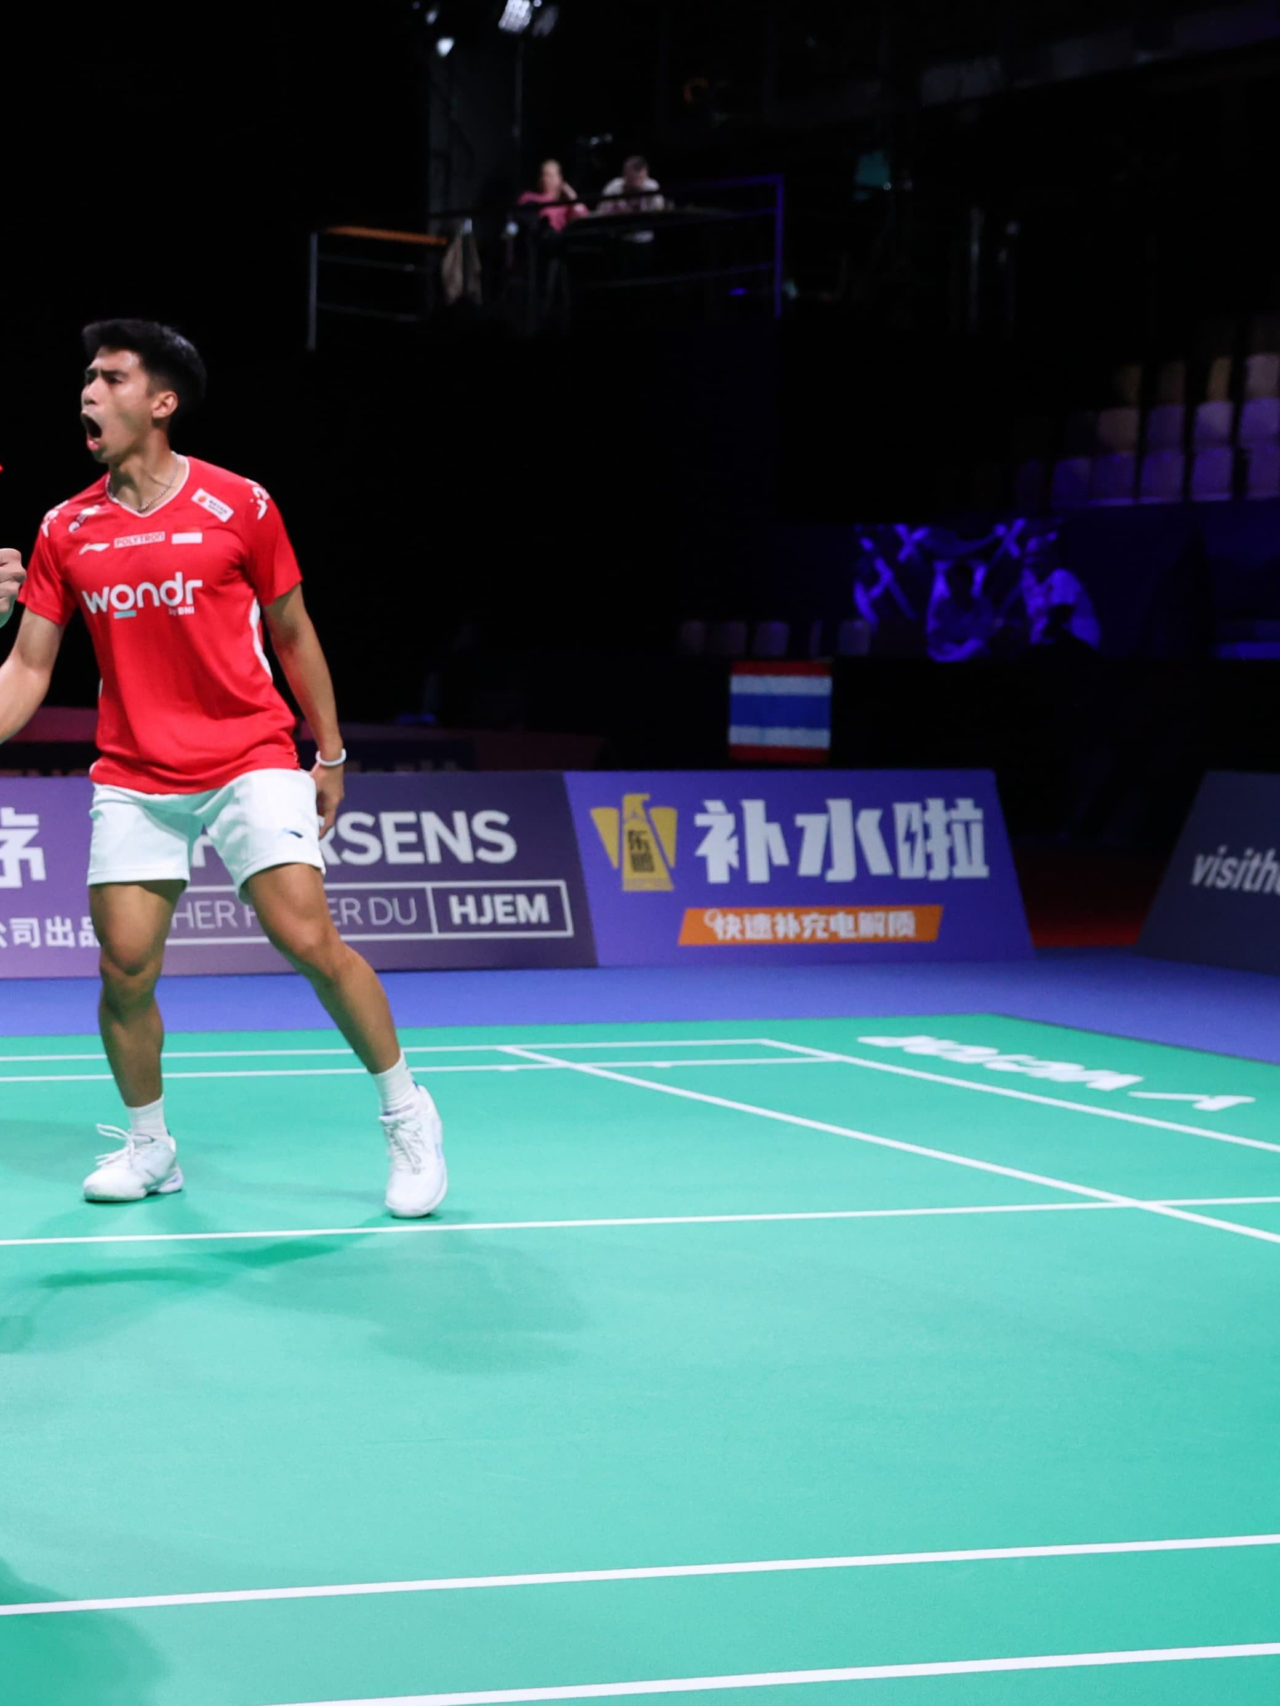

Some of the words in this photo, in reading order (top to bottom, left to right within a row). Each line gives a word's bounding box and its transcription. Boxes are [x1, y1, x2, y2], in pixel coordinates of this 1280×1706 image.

[82, 571, 203, 614] wondr
[694, 797, 990, 883] 补水啦
[1190, 845, 1280, 896] visith
[172, 899, 238, 930] HER
[369, 897, 417, 926] DU
[450, 893, 550, 925] HJEM
